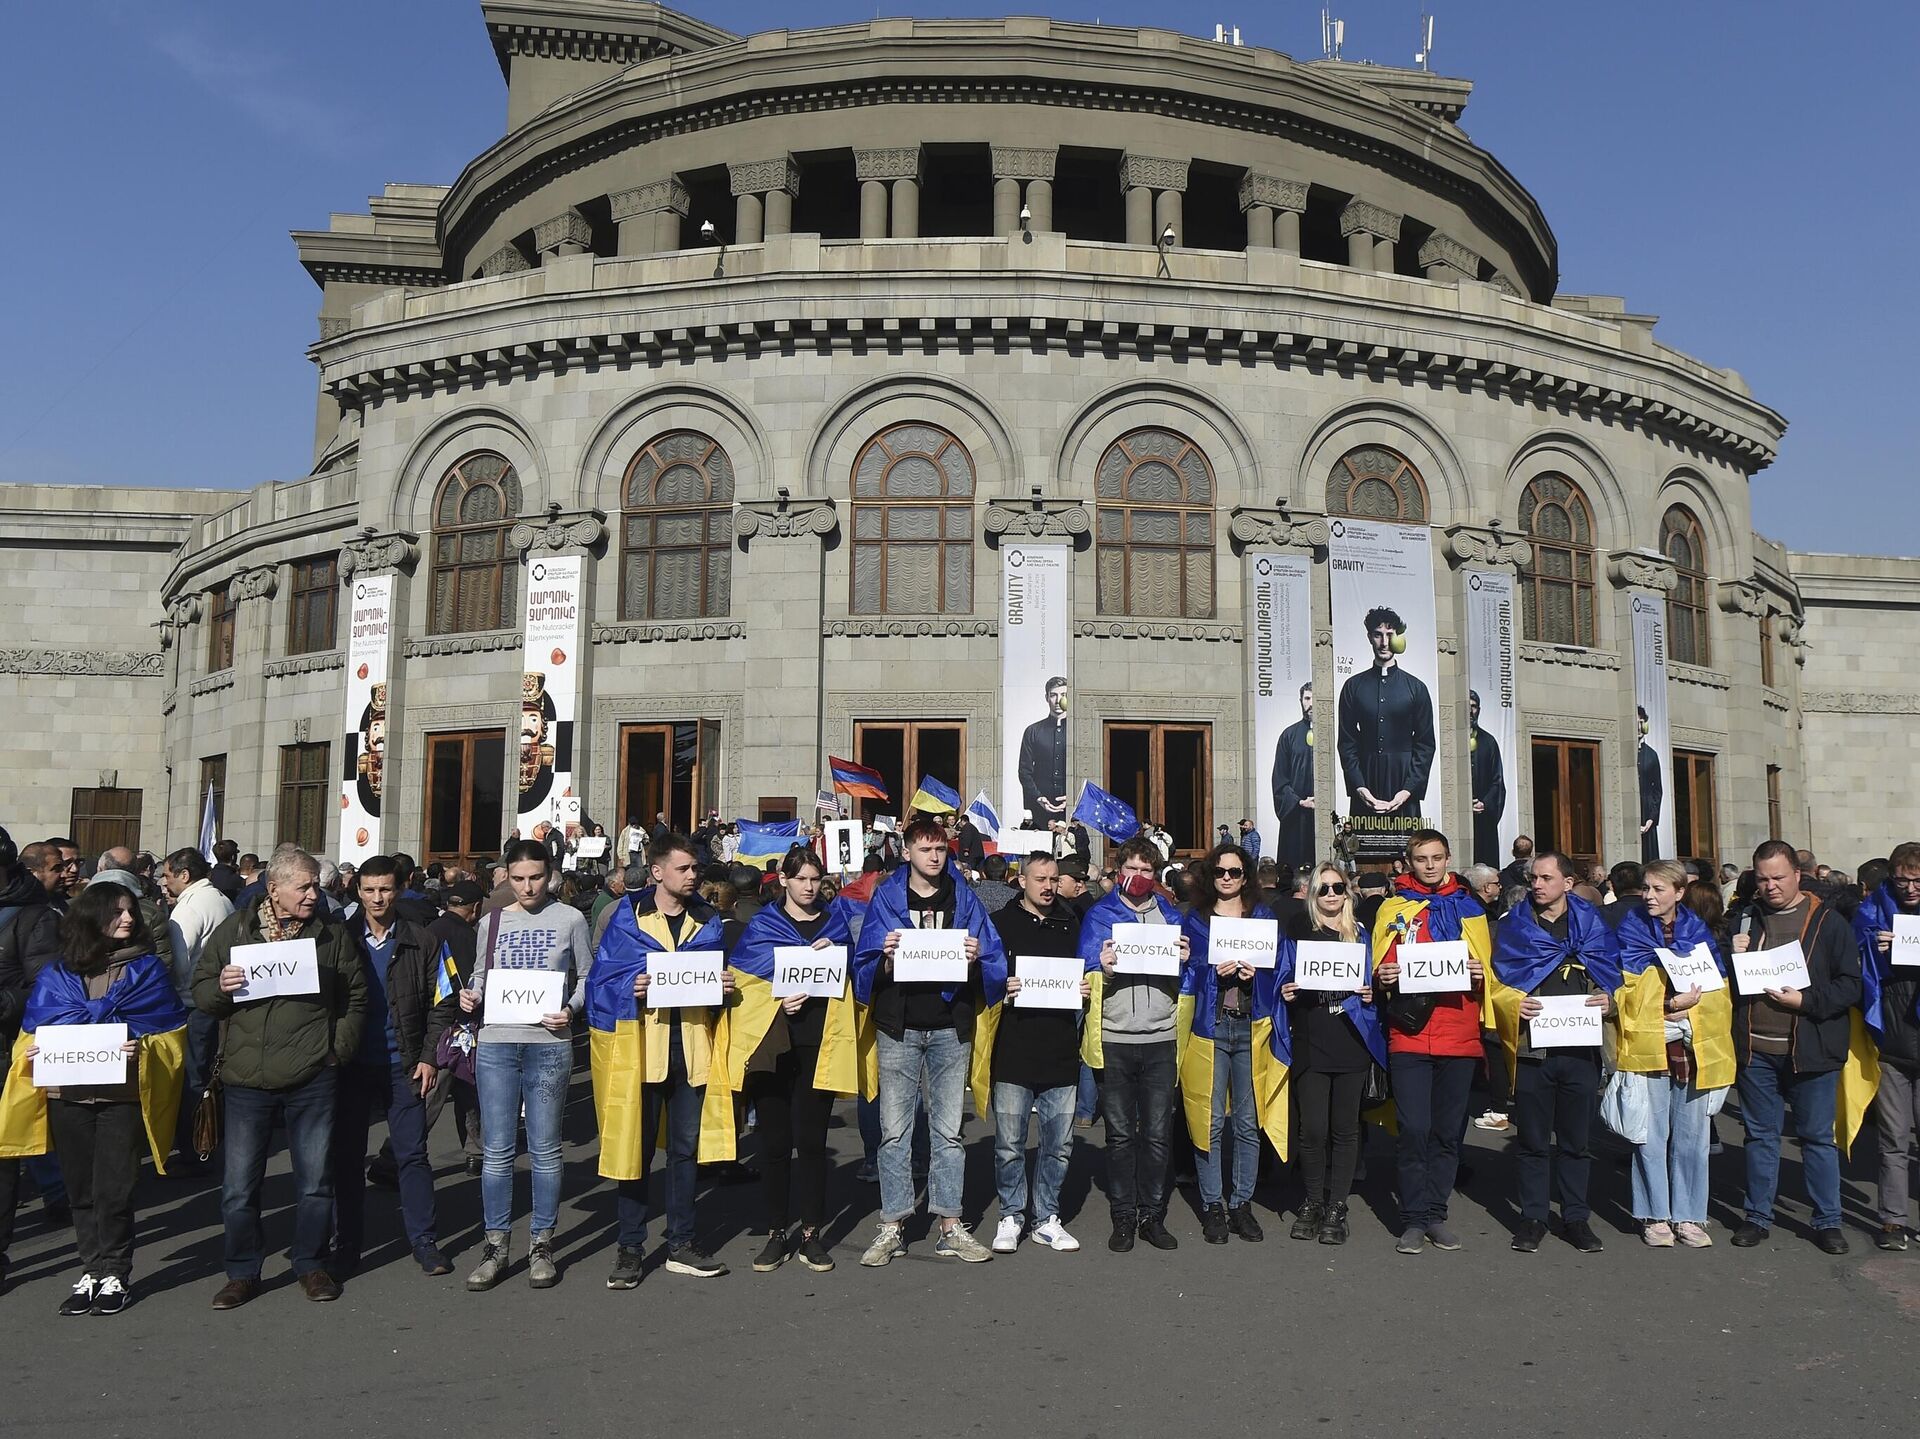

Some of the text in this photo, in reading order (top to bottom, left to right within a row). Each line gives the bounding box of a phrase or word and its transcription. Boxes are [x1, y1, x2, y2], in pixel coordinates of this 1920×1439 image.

[1332, 559, 1365, 572] GRAVITY
[1008, 573, 1024, 625] GRAVITY
[529, 623, 575, 632] The Nutcracker
[1653, 621, 1664, 666] GRAVITY
[498, 929, 557, 948] PEACE
[1216, 938, 1274, 951] KHERSON
[902, 950, 963, 960] MARIUPOL
[1114, 944, 1177, 957] AZOVSTAL
[501, 949, 549, 969] LOVE
[250, 960, 298, 980] KYIV
[781, 967, 842, 984] IRPEN
[1303, 960, 1361, 979] IRPEN
[1407, 958, 1465, 979] IZUM
[1668, 960, 1713, 977] BUCHA
[1743, 962, 1803, 977] MARIUPOL
[656, 970, 718, 986] BUCHA
[1024, 978, 1074, 990] KHARKIV
[502, 989, 546, 1005] KYIV
[1533, 1016, 1599, 1030] AZOVSTAL
[43, 1047, 123, 1064] KHERSON
